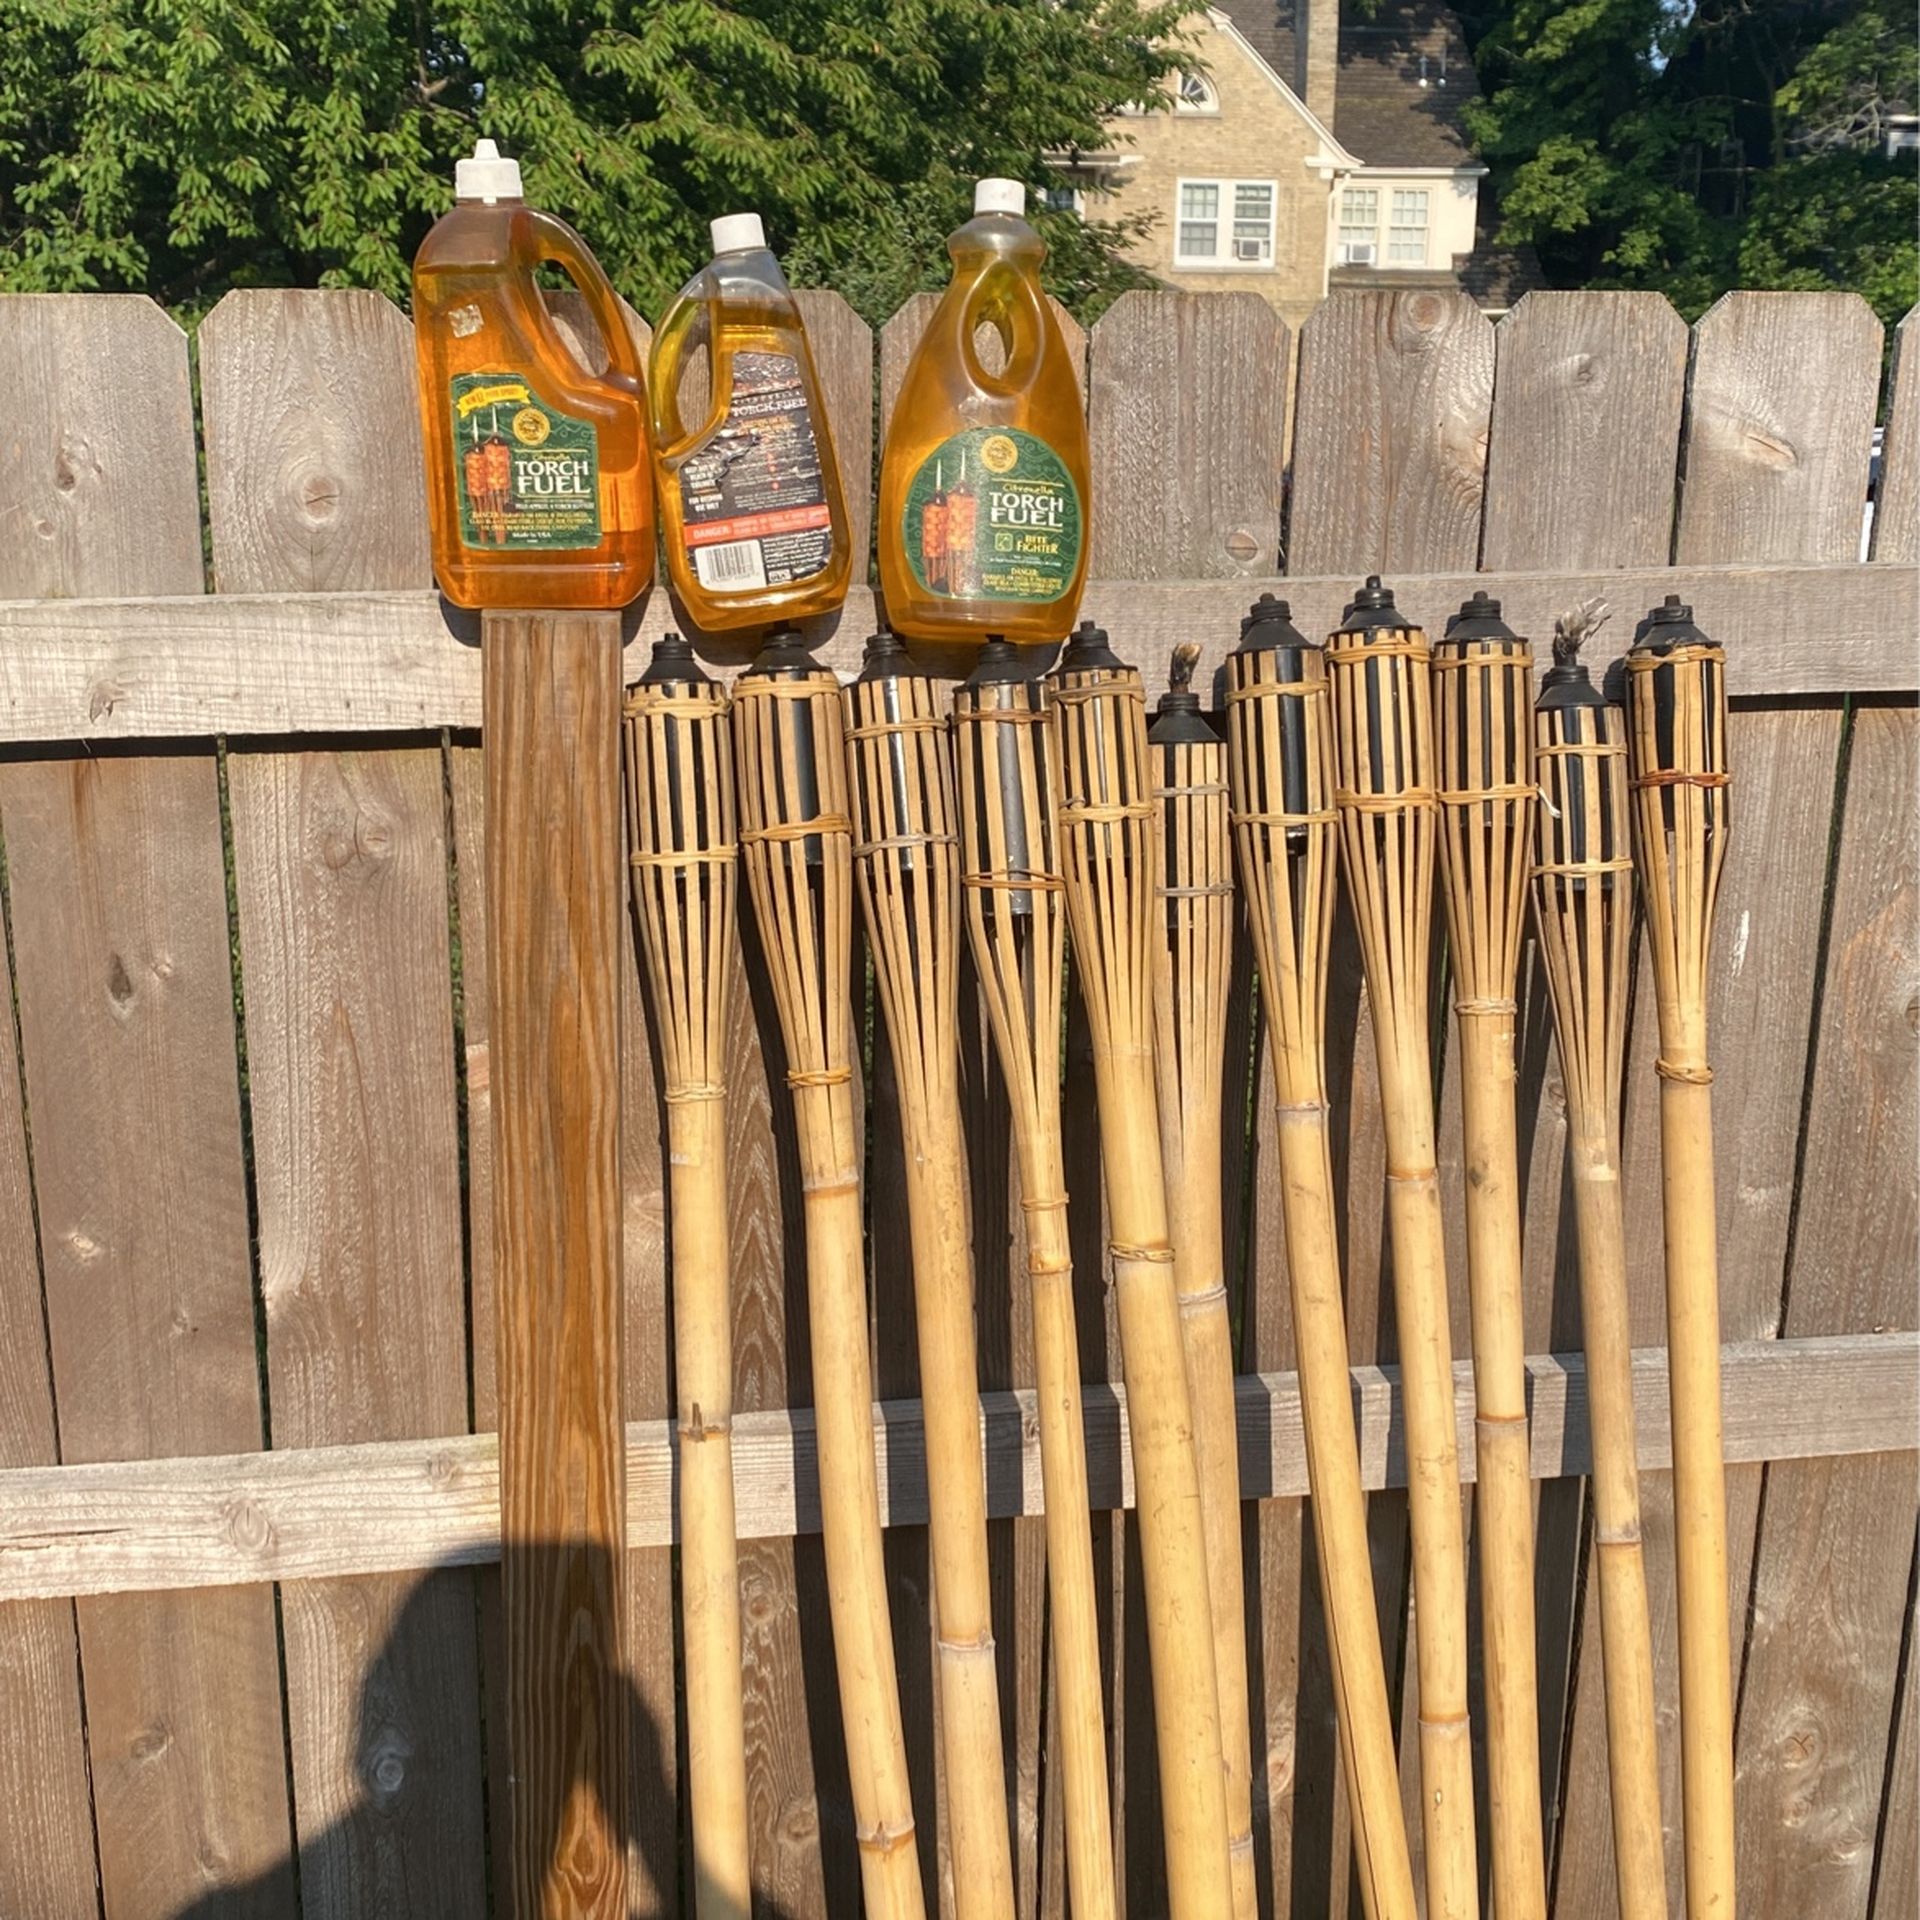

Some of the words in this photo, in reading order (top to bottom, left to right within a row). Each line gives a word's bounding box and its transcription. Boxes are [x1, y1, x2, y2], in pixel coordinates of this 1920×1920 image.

[514, 461, 589, 476] TORCH
[518, 476, 592, 494] FUEL
[1003, 484, 1055, 495] Citronella
[989, 492, 1064, 513] TORCH
[991, 507, 1064, 527] FUEL
[1017, 541, 1059, 554] FIGHTER
